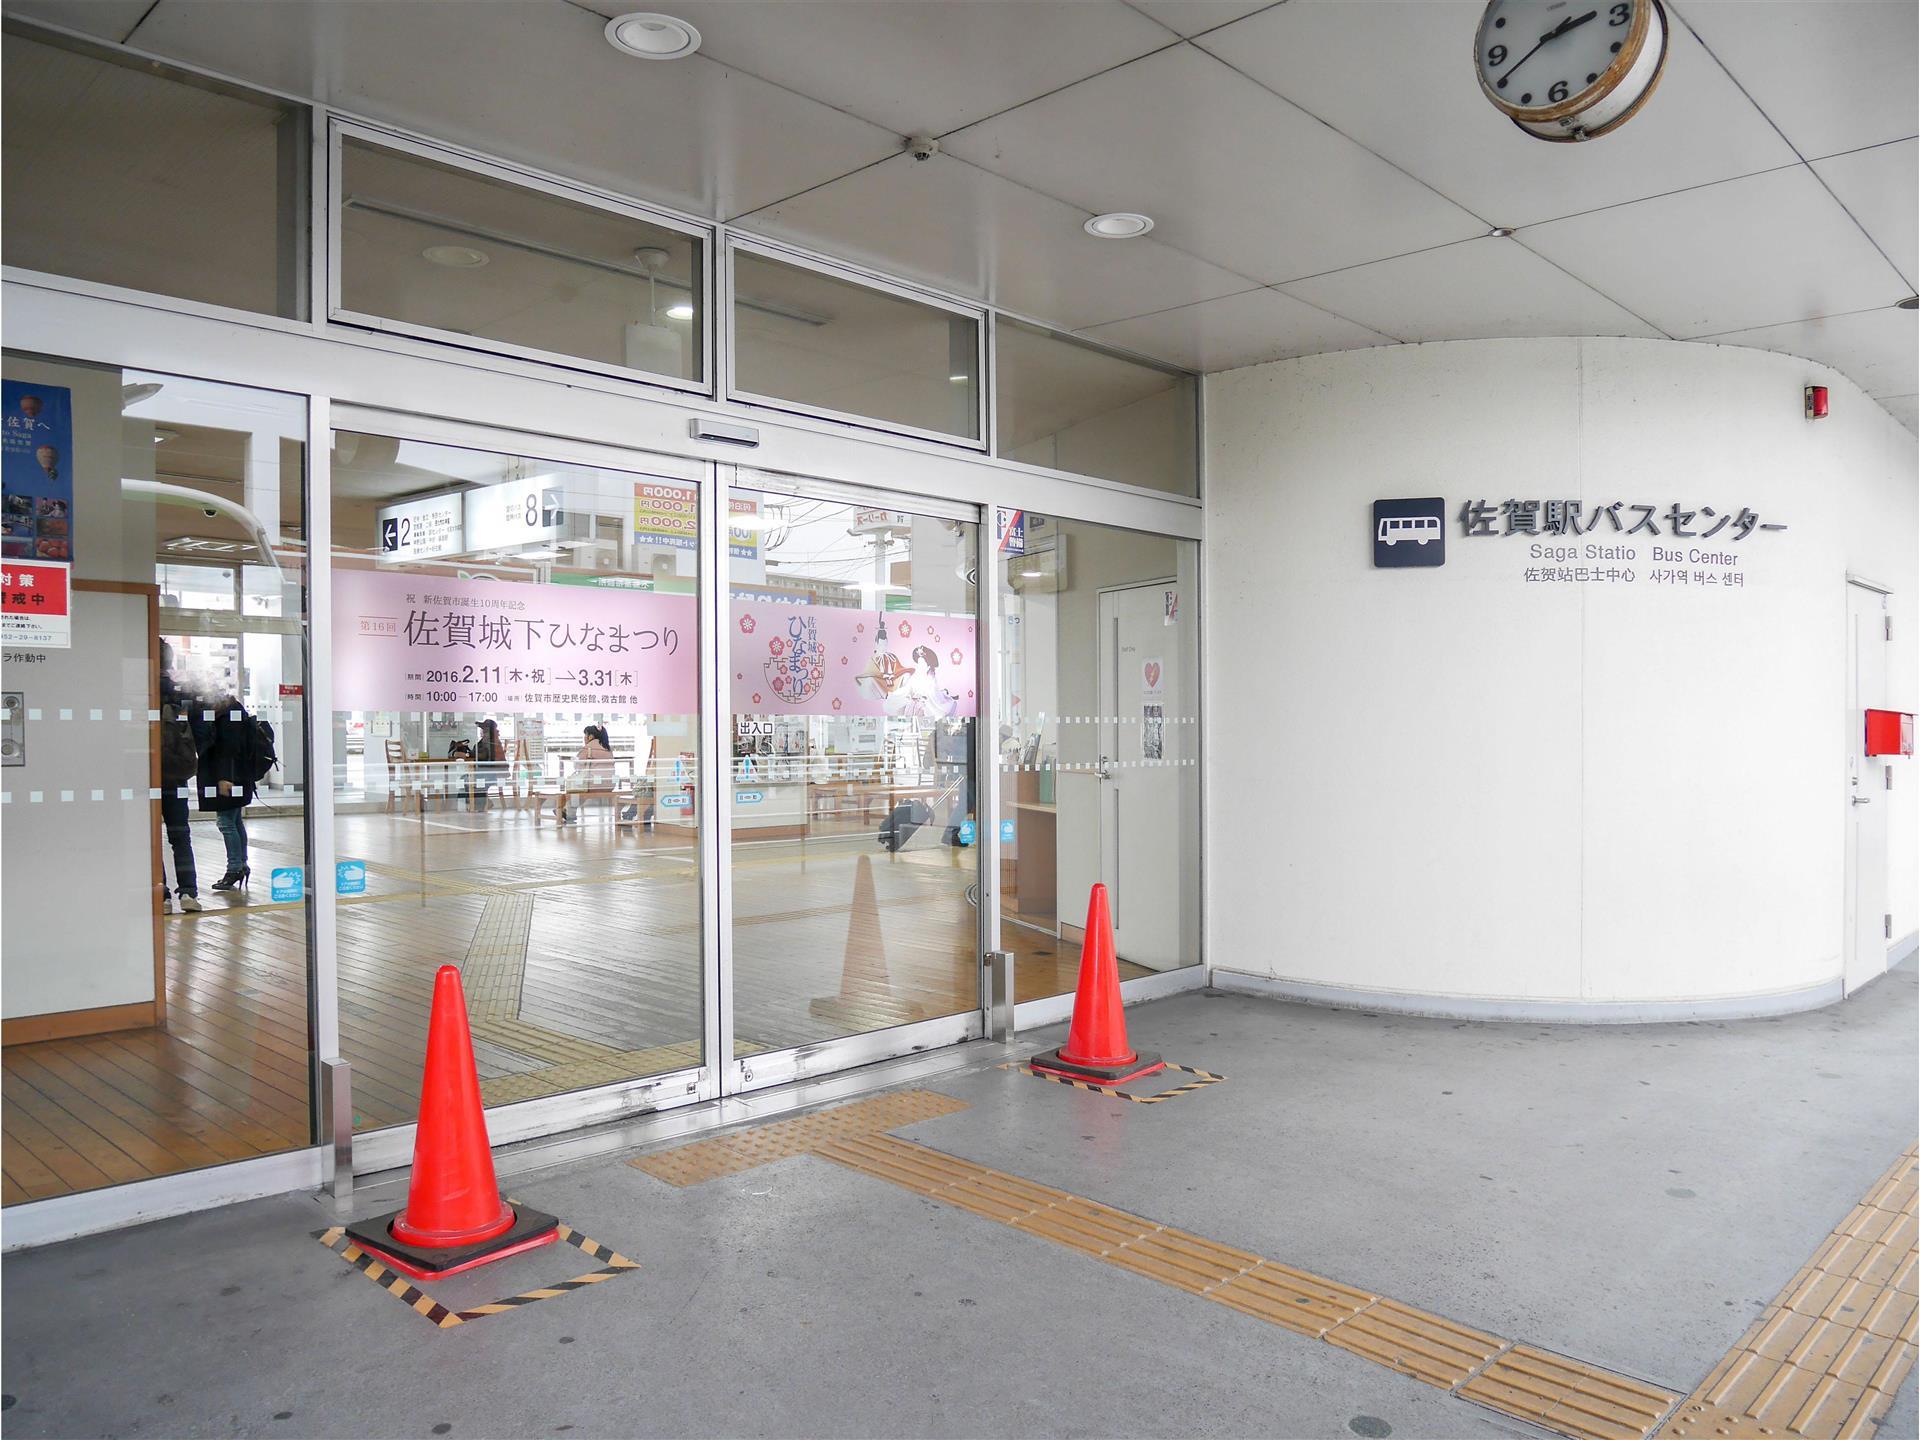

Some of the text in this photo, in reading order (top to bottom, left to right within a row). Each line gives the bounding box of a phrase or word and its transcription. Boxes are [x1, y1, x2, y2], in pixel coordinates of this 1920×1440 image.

[1609, 3, 1630, 27] 3
[1488, 45, 1507, 67] 9
[1548, 80, 1569, 103] 6
[2, 416, 51, 431] 佐賀へ
[525, 493, 538, 527] 8
[1458, 497, 1790, 541] 佐賀駅バスセンター
[400, 517, 411, 547] 2
[1530, 543, 1738, 566] Saga Statio Bus Center
[1523, 566, 1636, 584] 佐贺站巴士中心
[1649, 568, 1745, 588] 사가역 버스 센터
[406, 593, 526, 611] 祝 新佐賀市誕生10周年記念
[360, 620, 397, 633] 第16回
[403, 609, 679, 656] 佐賀城下ひなまつり
[3, 652, 46, 664] ラ作動中
[787, 615, 809, 697] ひなまつり
[629, 695, 639, 705] 他
[740, 722, 773, 735] 出入口
